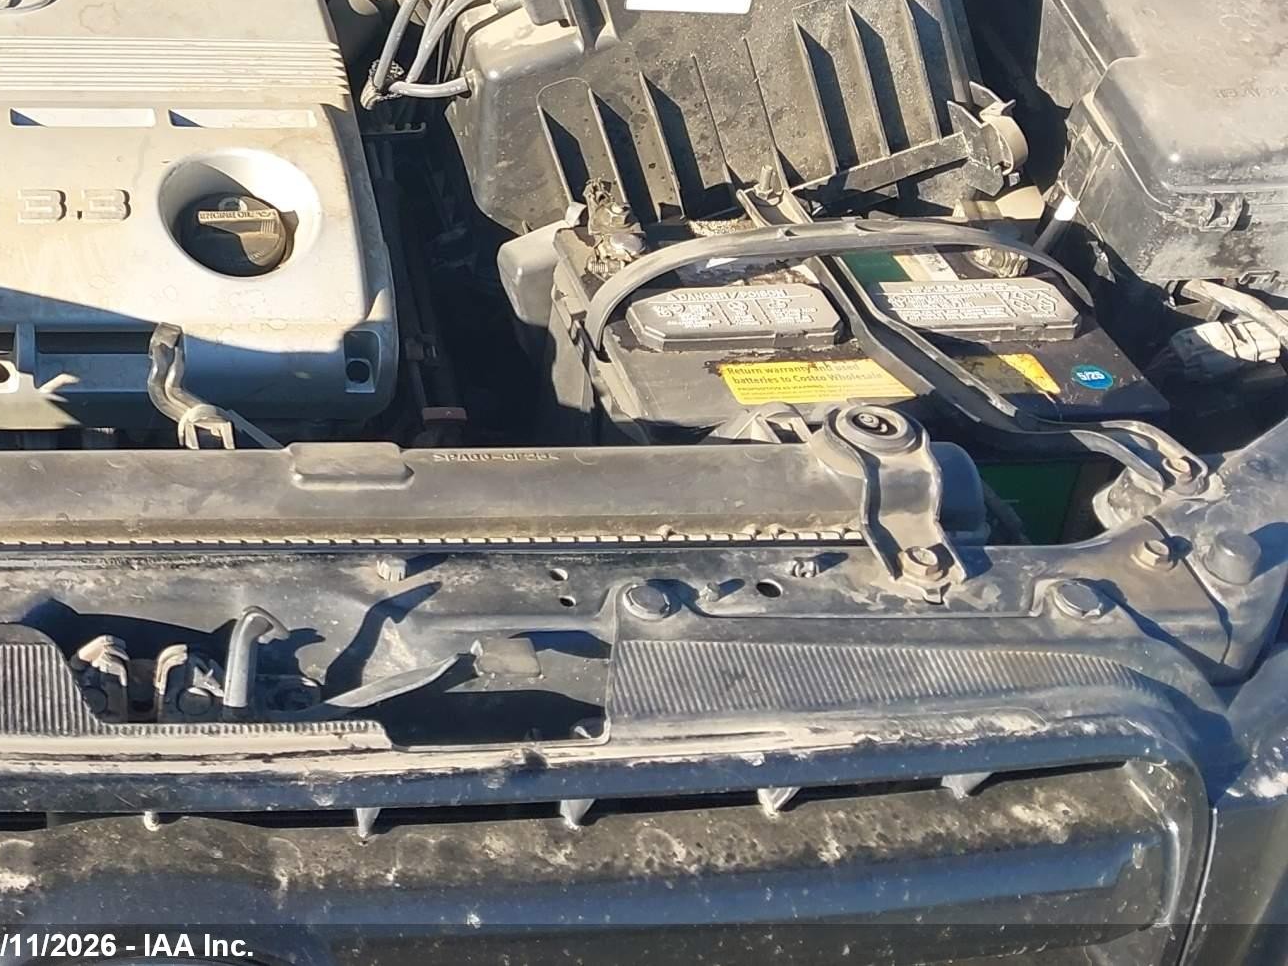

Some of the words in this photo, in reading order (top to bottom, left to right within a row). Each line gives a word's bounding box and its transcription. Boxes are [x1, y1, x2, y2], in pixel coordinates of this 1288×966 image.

[16, 187, 133, 224] 3.3
[728, 367, 762, 375] Return
[766, 365, 811, 374] warranty
[733, 376, 778, 384] batteries
[793, 374, 827, 383] Costco
[828, 372, 882, 382] Wholesale
